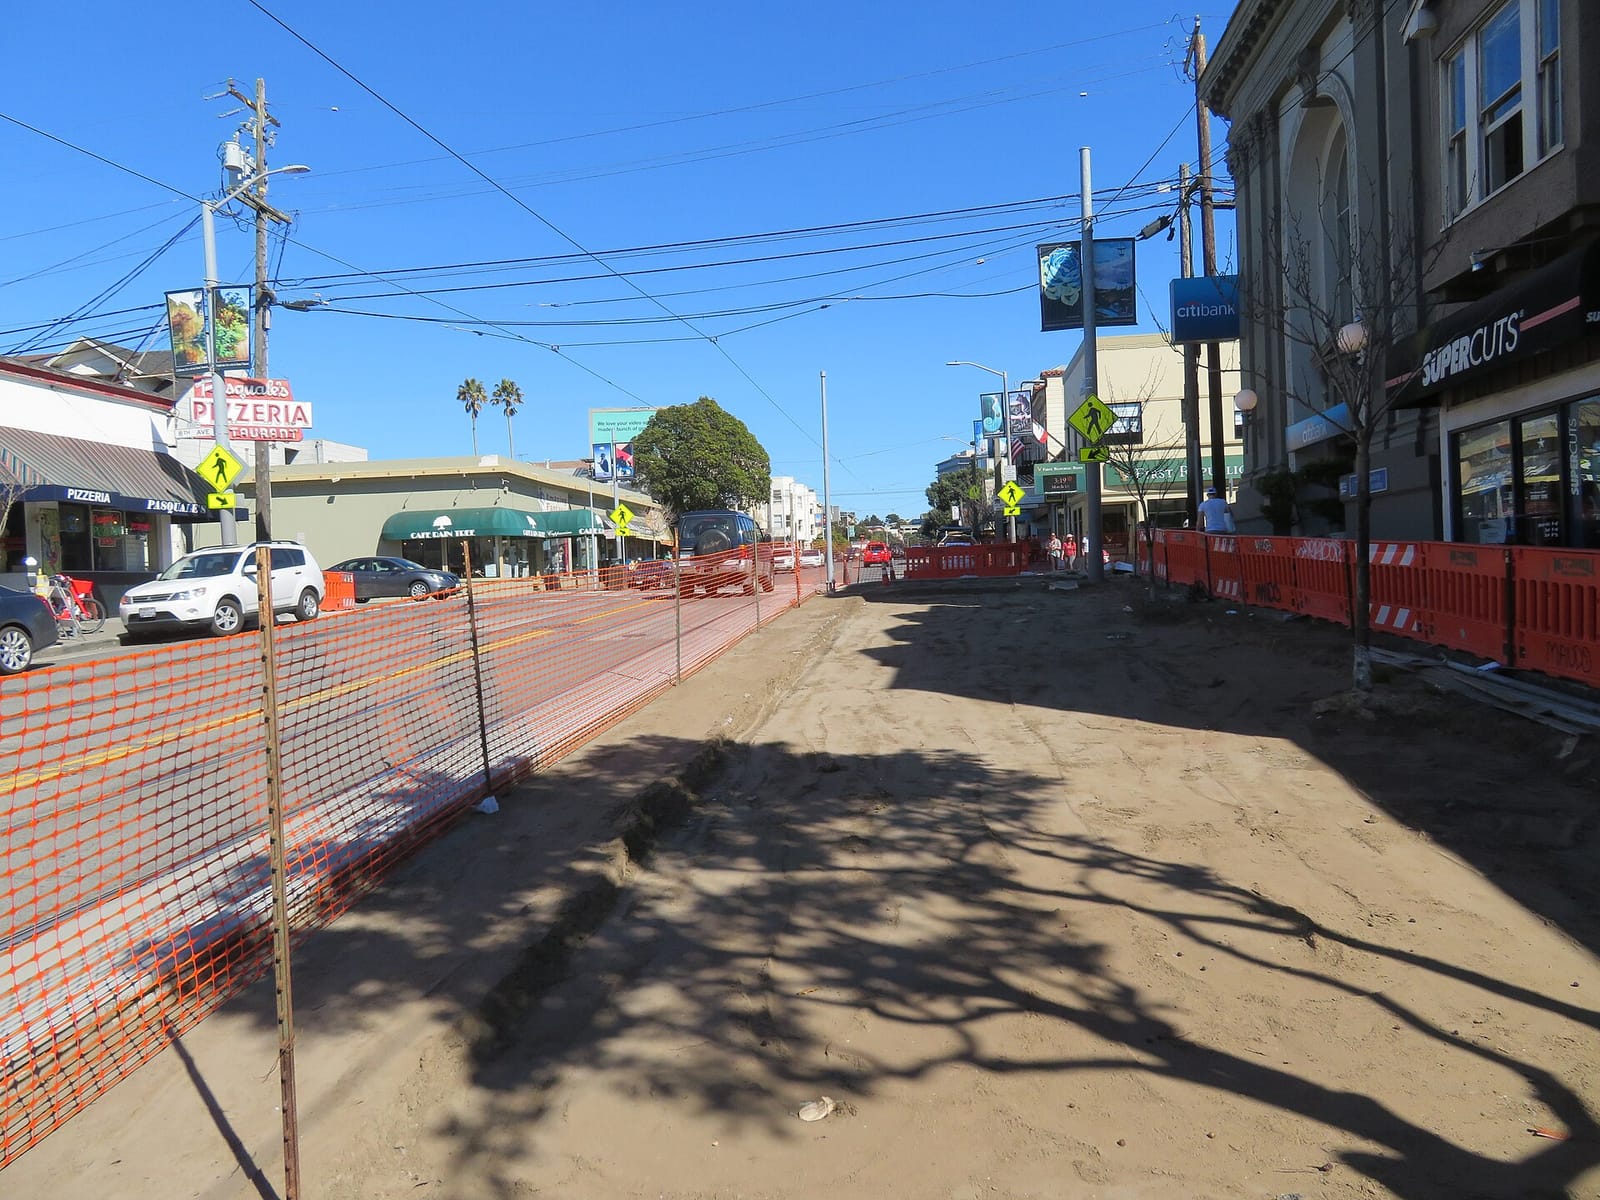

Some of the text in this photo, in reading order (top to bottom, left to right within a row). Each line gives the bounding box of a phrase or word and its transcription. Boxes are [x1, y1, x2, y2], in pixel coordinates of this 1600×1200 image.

[1177, 302, 1236, 318] citibank
[1422, 311, 1521, 387] SUPERCUTS
[194, 379, 289, 400] Psquale's
[193, 401, 310, 425] PIZERIA
[1568, 418, 1579, 496] SUPERCUTS
[67, 488, 111, 504] PIZZERIA
[454, 529, 476, 537] TREE
